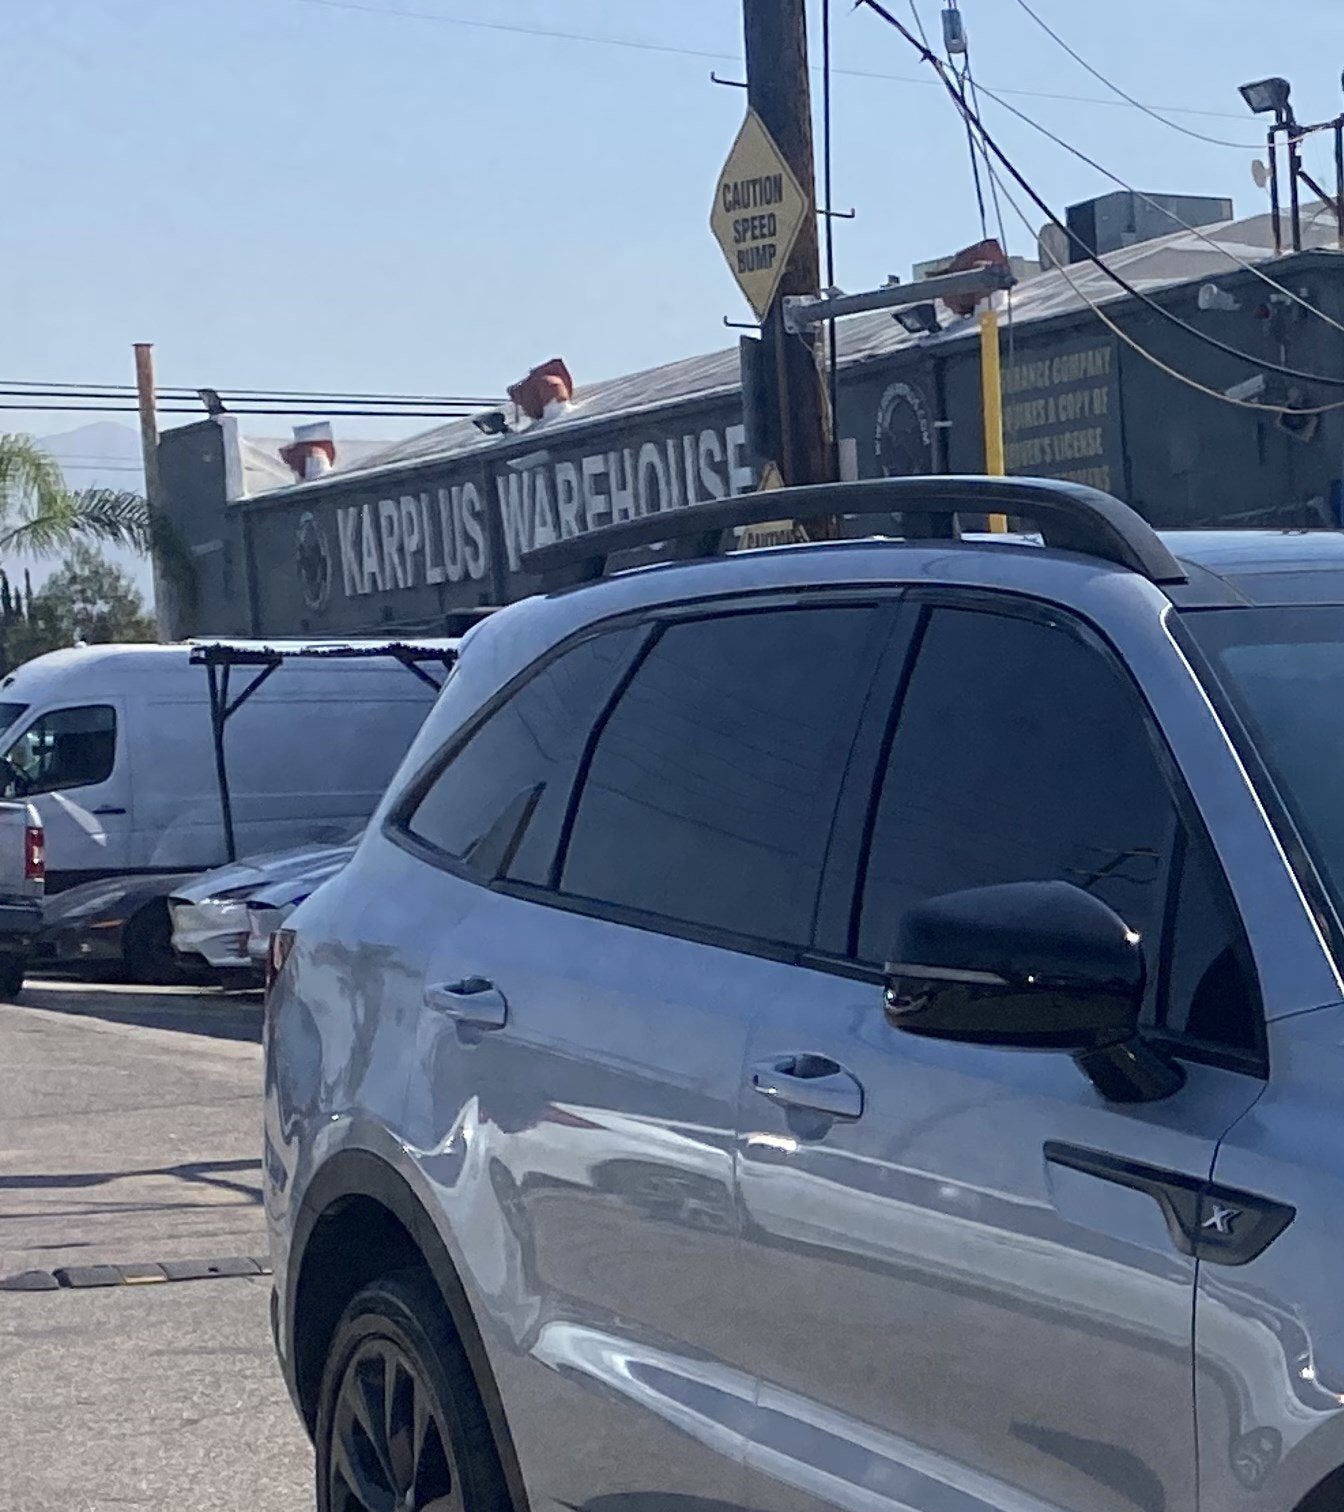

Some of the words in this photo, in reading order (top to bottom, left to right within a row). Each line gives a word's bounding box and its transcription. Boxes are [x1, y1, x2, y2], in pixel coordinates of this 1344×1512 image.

[722, 173, 783, 213] CAUTION
[733, 212, 777, 244] SPEED
[737, 243, 776, 274] BUMP
[1053, 346, 1111, 384] COMPANY
[1048, 397, 1057, 423] A
[1058, 390, 1090, 422] COPY
[1053, 427, 1103, 461] LICENSE
[337, 482, 487, 597] KARPLUS
[497, 423, 758, 572] WAREHOUSE
